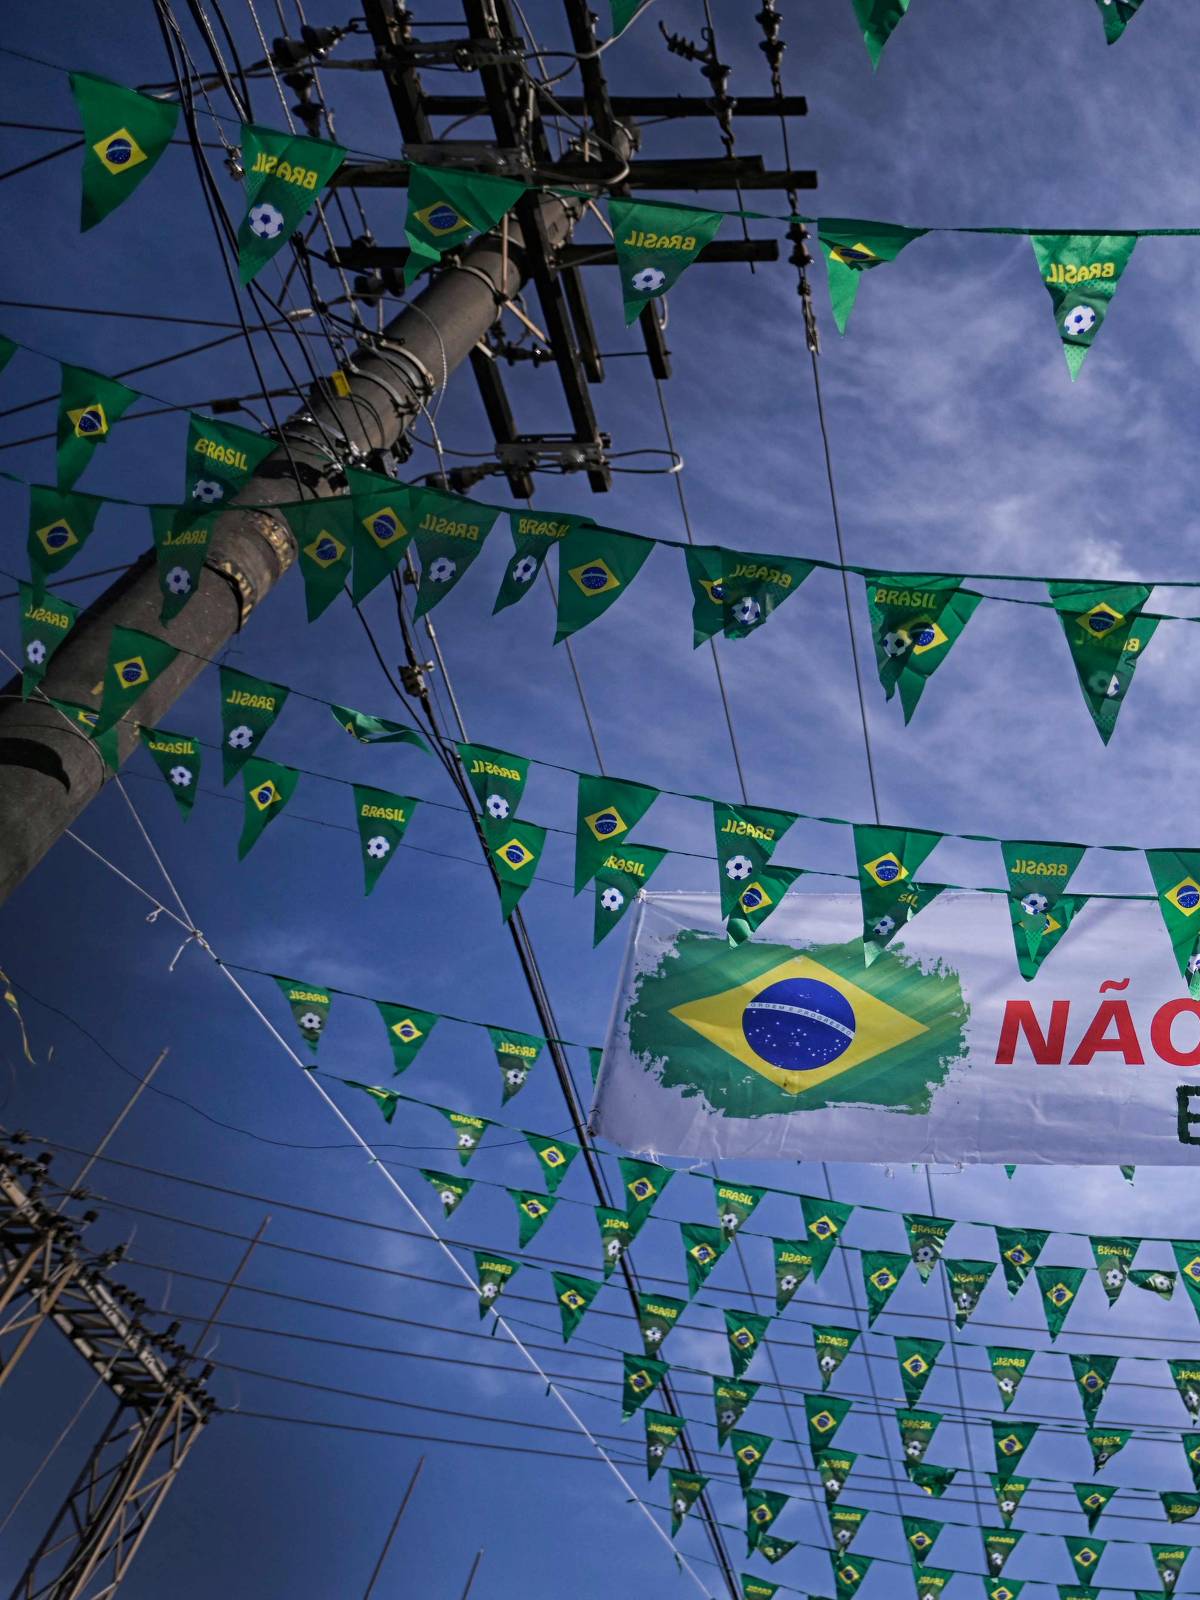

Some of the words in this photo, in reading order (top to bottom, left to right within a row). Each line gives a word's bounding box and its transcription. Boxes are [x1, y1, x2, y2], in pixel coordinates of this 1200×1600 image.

[196, 439, 247, 470] BRASIL
[876, 588, 936, 608] BRASIL
[362, 805, 404, 822] BRASIL
[898, 893, 918, 908] SIL
[720, 1189, 752, 1204] BRASIL
[912, 1224, 945, 1238] BRASIL
